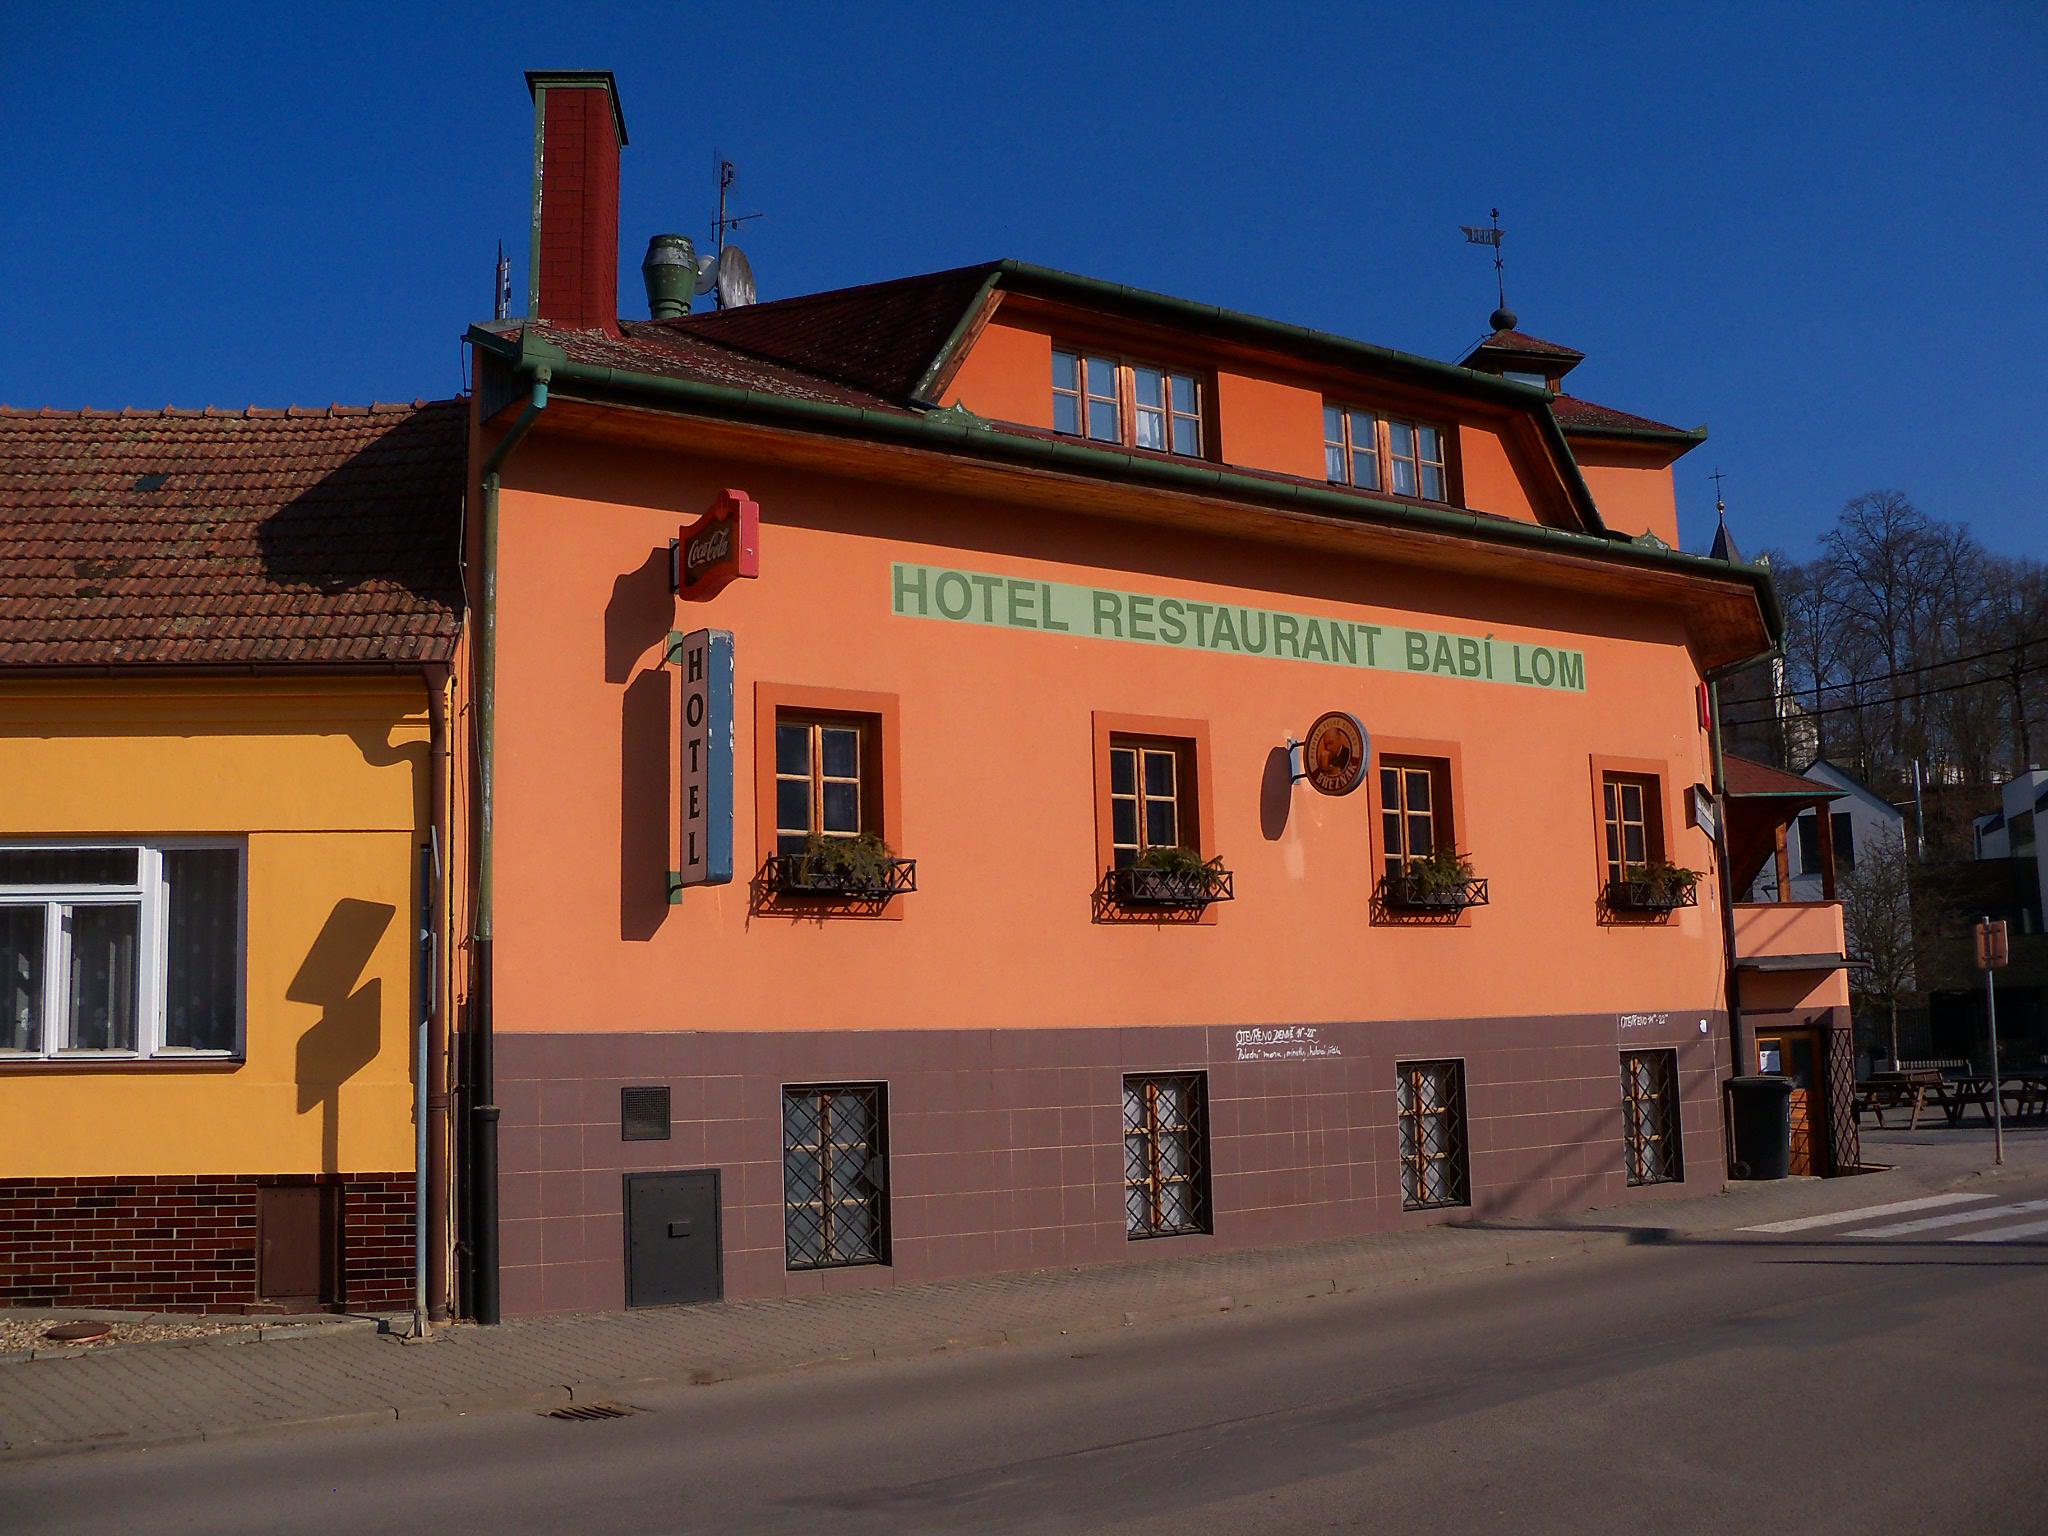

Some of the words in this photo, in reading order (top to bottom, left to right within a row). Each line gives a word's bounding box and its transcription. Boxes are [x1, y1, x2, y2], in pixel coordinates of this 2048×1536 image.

[894, 565, 1069, 632] HOTEL
[1093, 590, 1382, 666] RESTAURANT
[1405, 633, 1494, 680] BABÍ
[1513, 645, 1585, 690] LOM
[686, 645, 704, 866] HOTEL
[1235, 1028, 1272, 1043] OTEVŘENO
